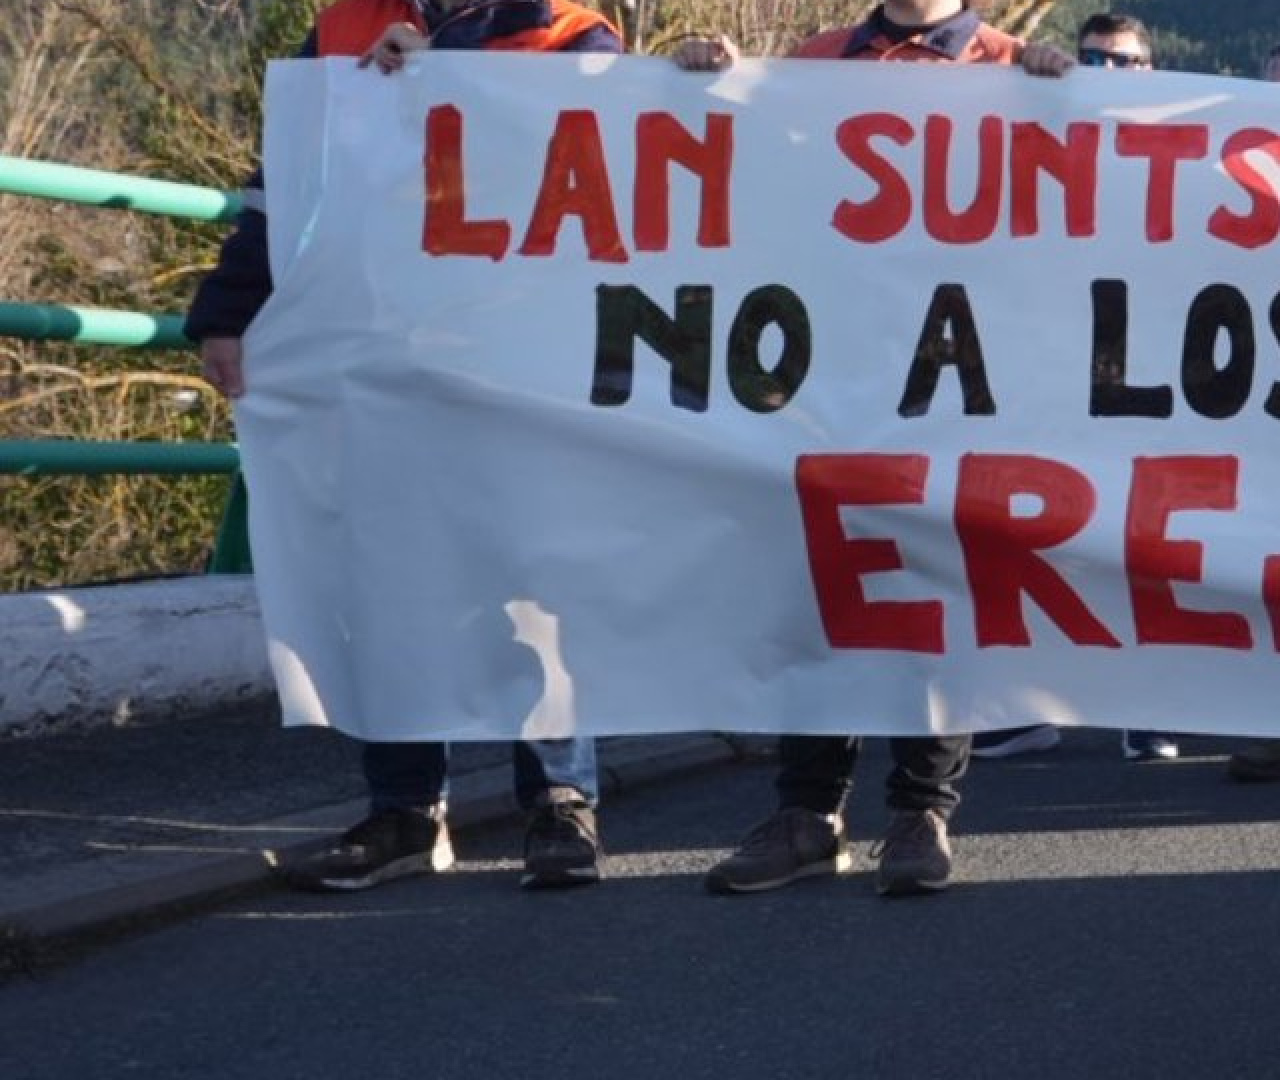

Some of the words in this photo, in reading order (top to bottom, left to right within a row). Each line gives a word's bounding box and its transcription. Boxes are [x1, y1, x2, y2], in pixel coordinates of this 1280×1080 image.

[422, 104, 734, 263] LAN
[591, 283, 812, 413] NO
[898, 283, 996, 418] A
